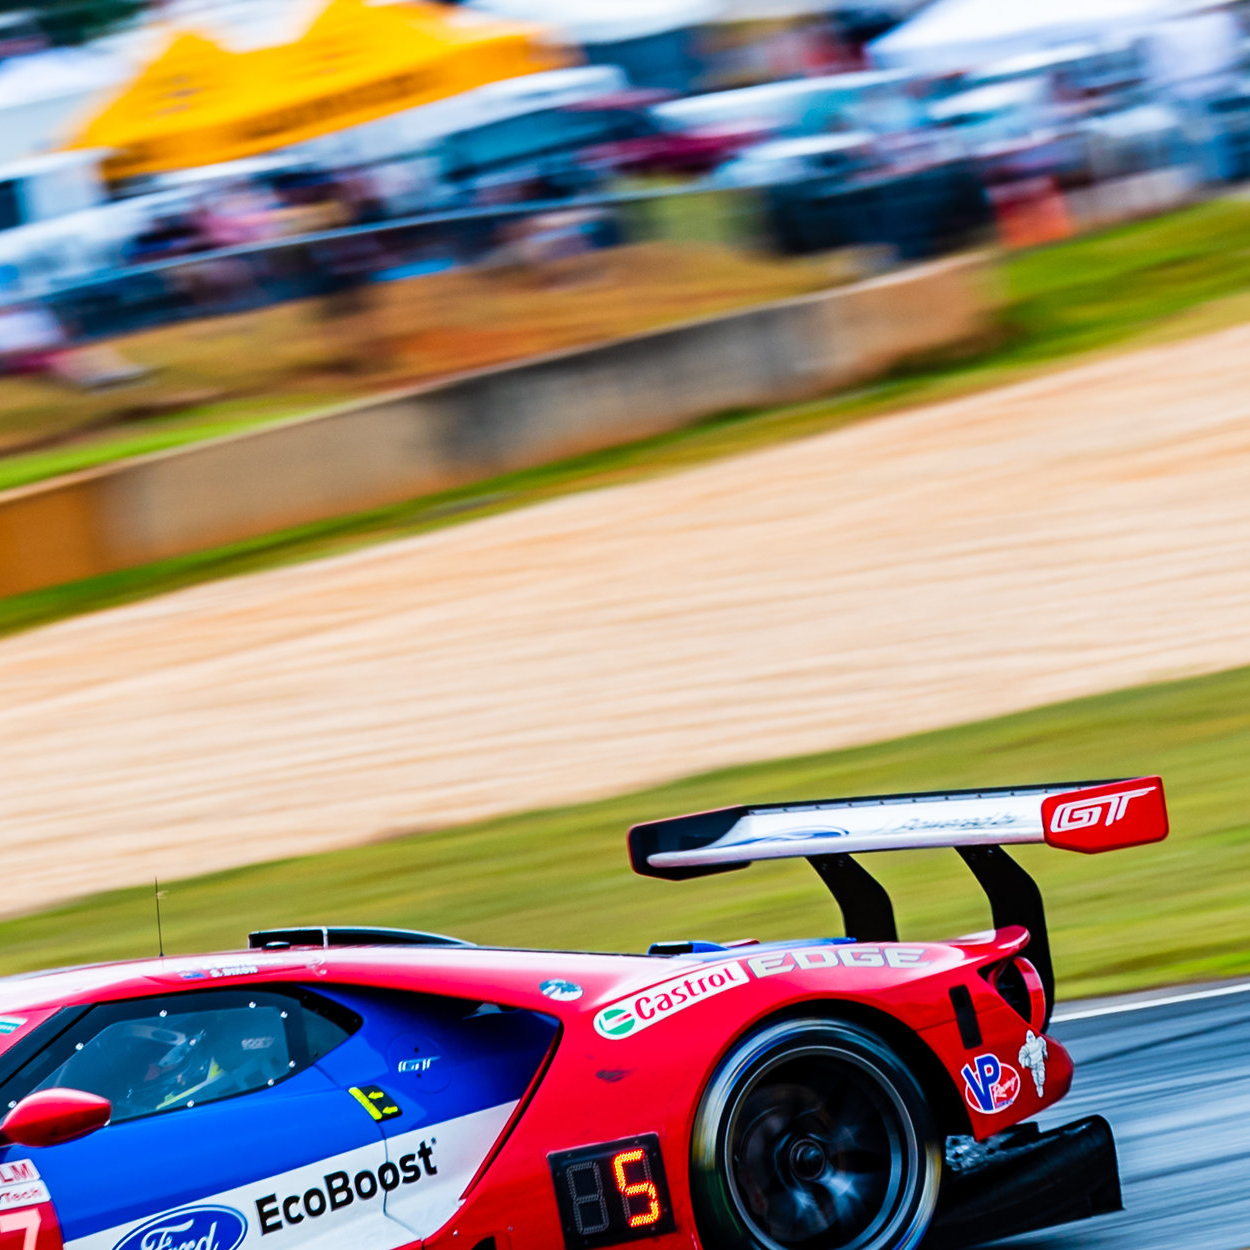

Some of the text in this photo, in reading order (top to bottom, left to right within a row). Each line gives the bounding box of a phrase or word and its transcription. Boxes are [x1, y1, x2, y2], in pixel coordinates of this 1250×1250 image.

[1050, 787, 1157, 833] GT
[634, 947, 934, 1020] Castrol EDGE
[960, 1053, 1002, 1112] VP
[255, 1140, 438, 1236] EcoBoost
[613, 1149, 660, 1228] 5
